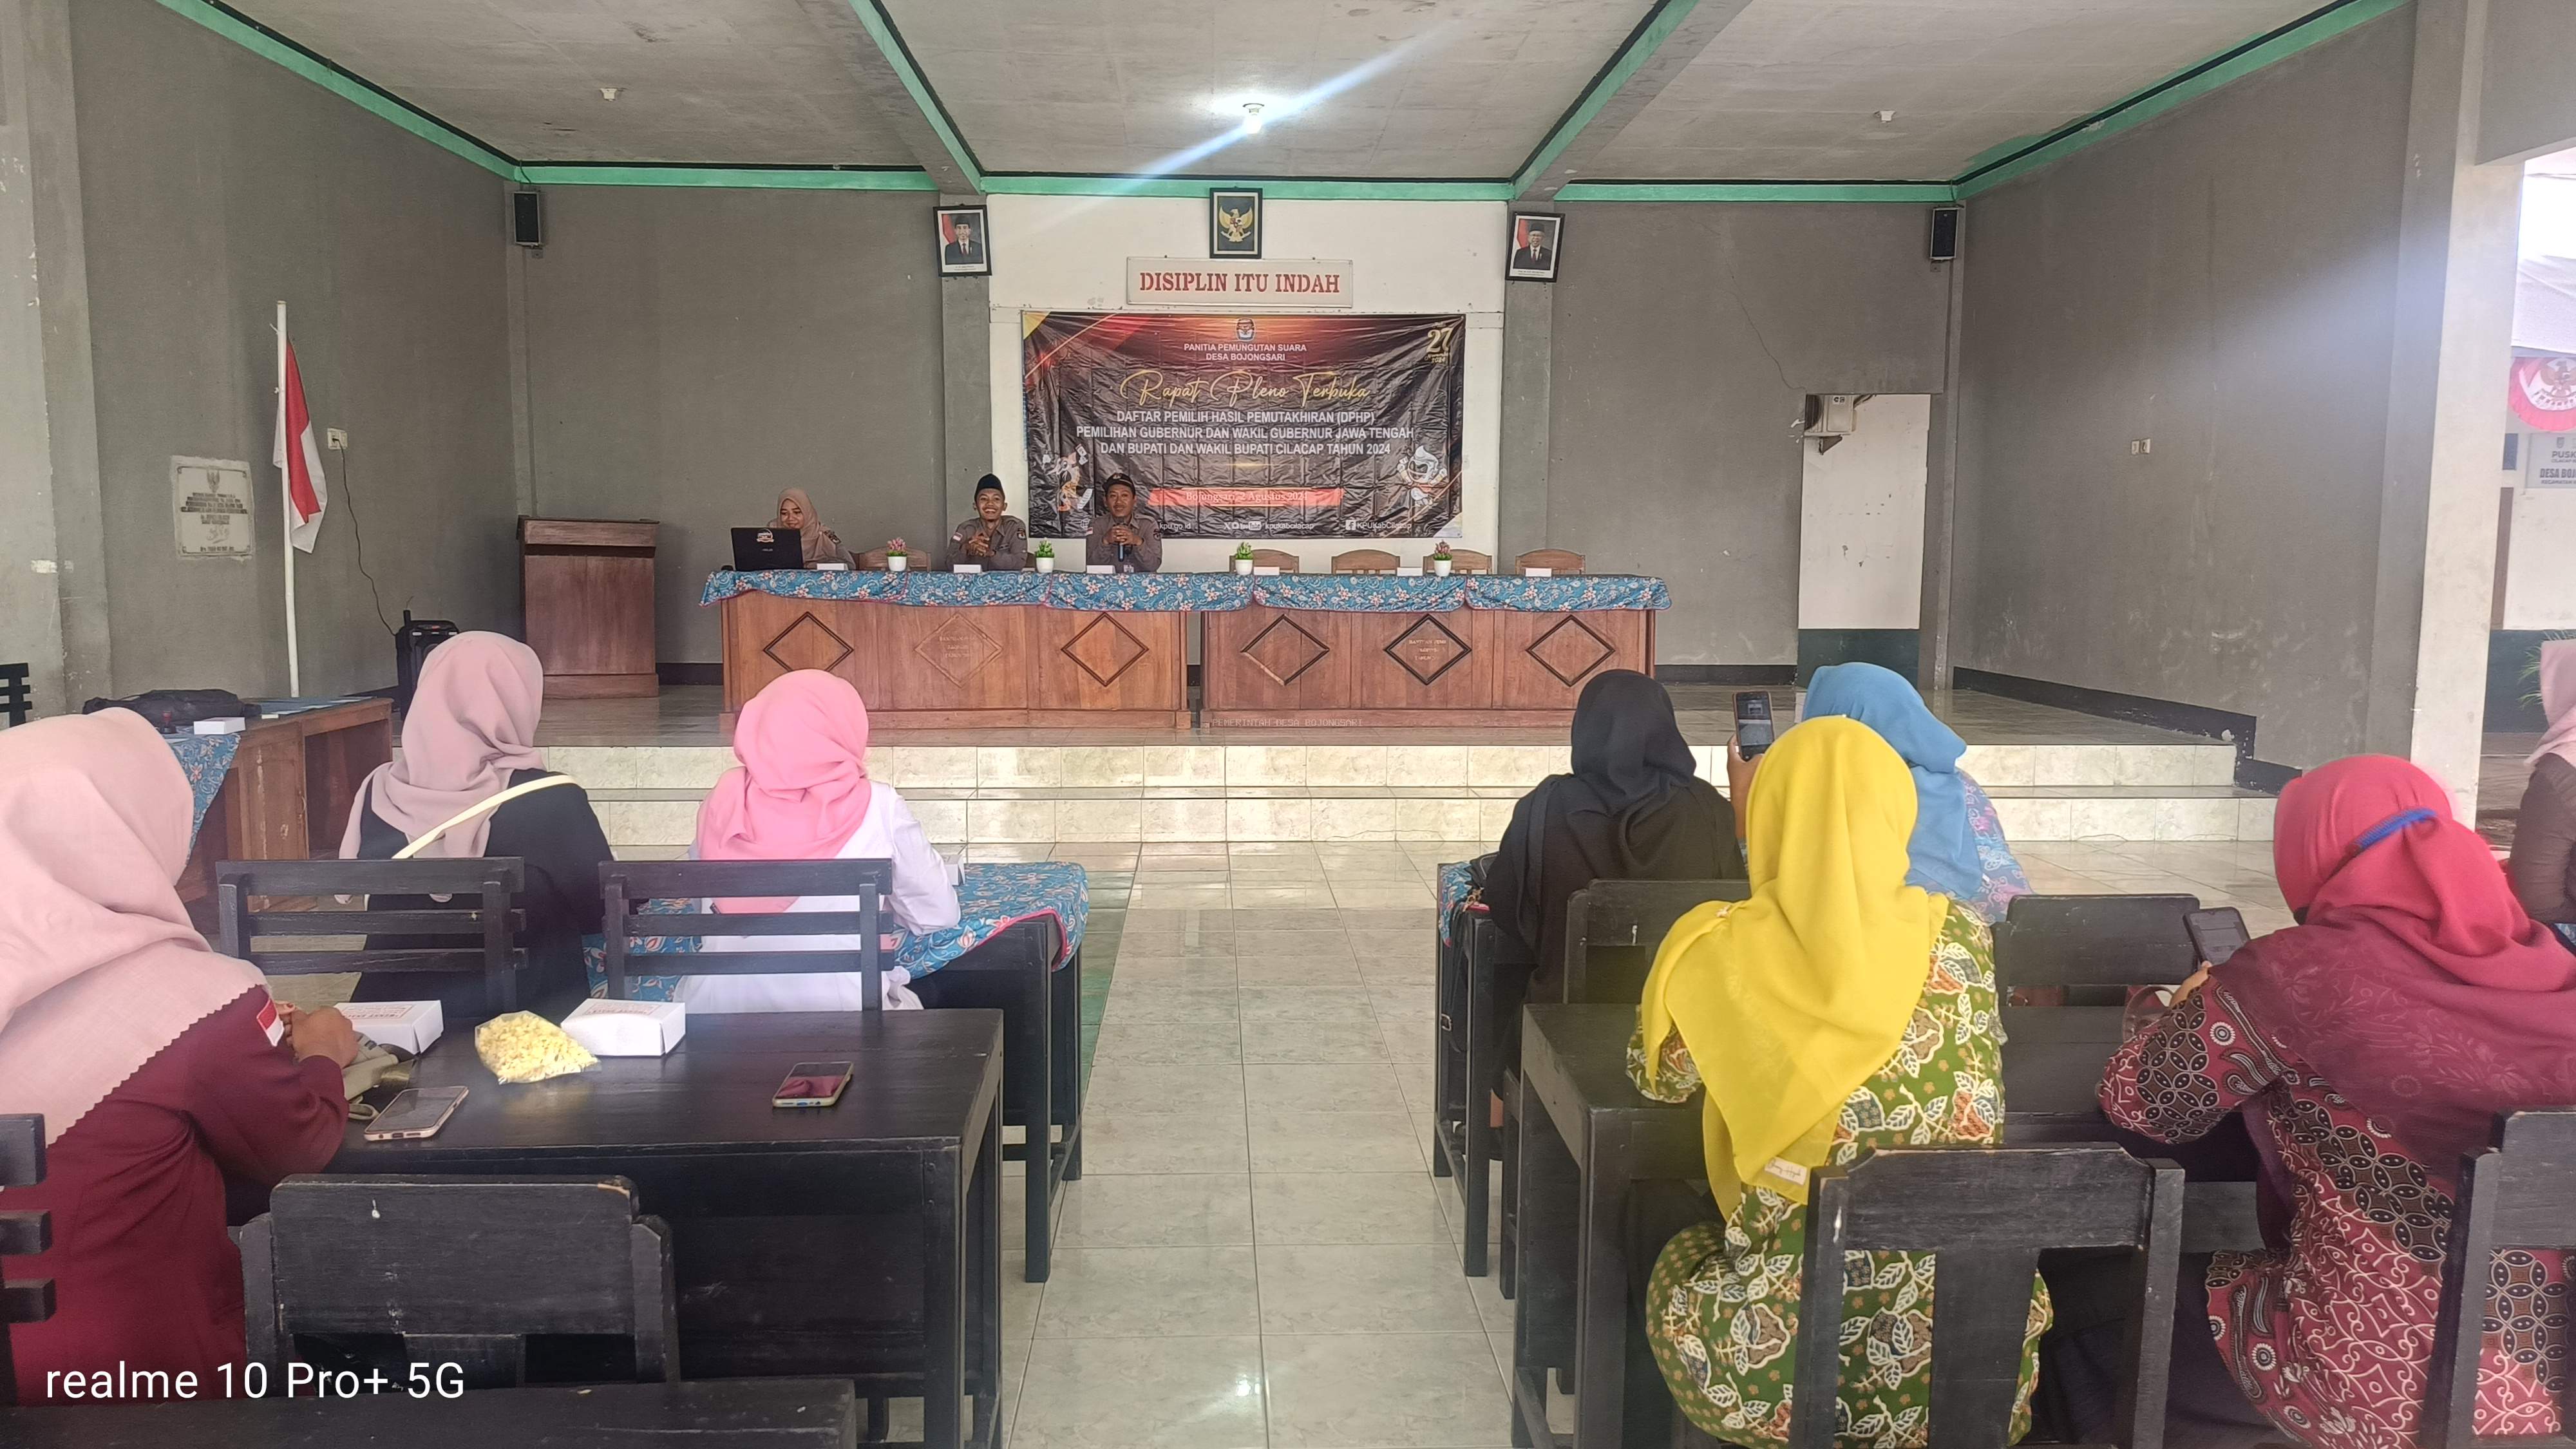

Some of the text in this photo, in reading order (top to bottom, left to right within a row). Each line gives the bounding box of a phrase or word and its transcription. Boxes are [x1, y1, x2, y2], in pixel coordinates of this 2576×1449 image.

[1139, 272, 1340, 293] DISIPLIN ITU INDAH
[1426, 327, 1454, 353] 27
[1218, 343, 1276, 352] PEMUNGUTAN
[1277, 343, 1307, 352] SUARA
[1230, 353, 1285, 361] BOJONGSARI
[1120, 369, 1371, 408] Rapat Pleno Terbuka
[1117, 410, 1376, 425] DAFTAR PEMILIH HASIL PEMUTAKHIRAN (DPHP)
[1076, 426, 1414, 439] PEMILIHAN GUBERNUR DAN WAKIL GUBERNUR JAWA TENGAH
[1101, 442, 1391, 455] DAN BUPATI DAN WAKIL BUPATI CILACAP TAHUN 2024
[2540, 468, 2559, 478] DESA
[1240, 492, 1245, 500] 2
[1247, 491, 1285, 503] Agustus
